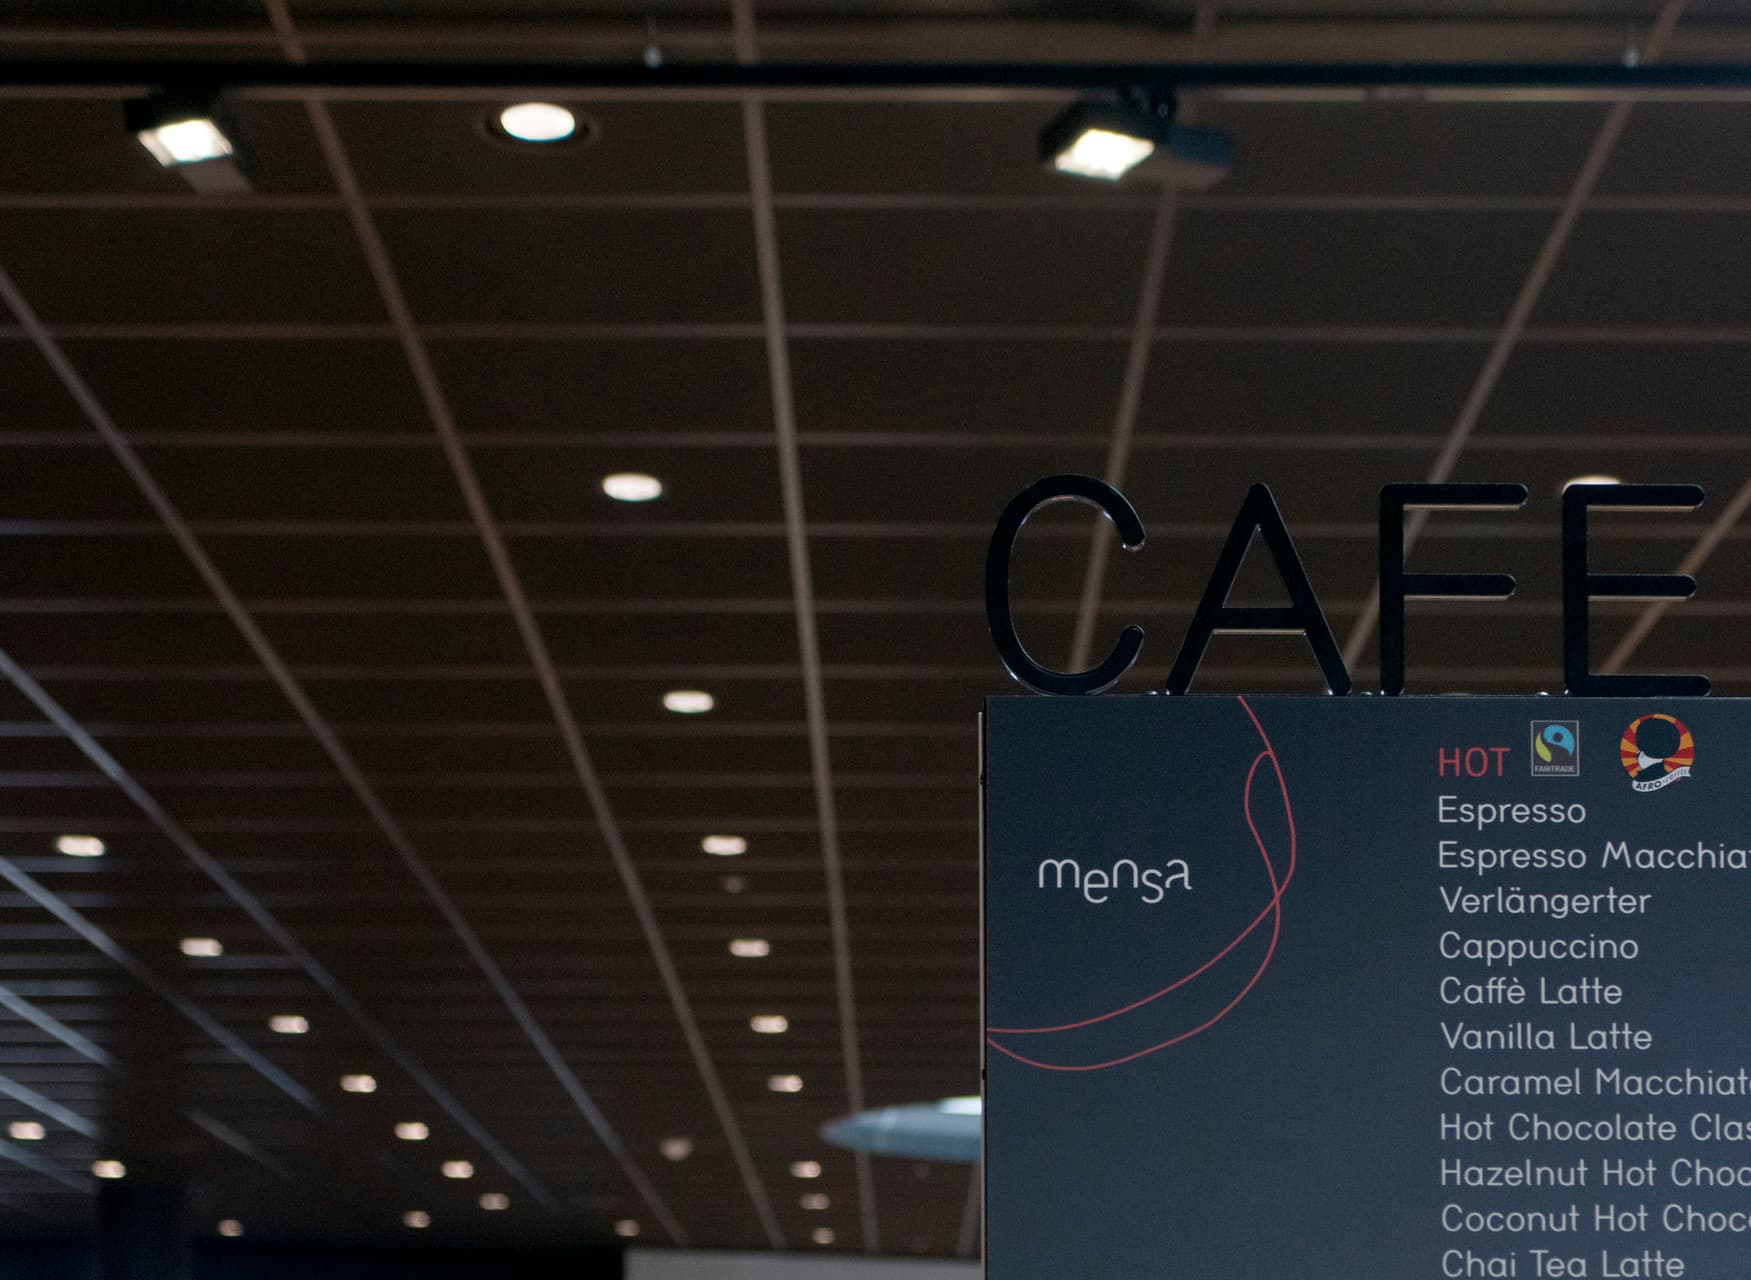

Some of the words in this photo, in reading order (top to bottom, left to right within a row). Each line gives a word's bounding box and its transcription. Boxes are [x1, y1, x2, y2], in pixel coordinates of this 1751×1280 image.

[984, 473, 1713, 696] CAFE
[1439, 746, 1510, 778] HOT
[1534, 765, 1576, 774] FAIRTRADE
[1438, 795, 1587, 831] Espresso
[1438, 840, 1587, 877] Espresso
[1601, 841, 1751, 870] Macchia
[1038, 858, 1193, 904] mensa
[1439, 886, 1652, 920] Verlängerter
[1439, 930, 1639, 967] Cappuccino
[1440, 976, 1526, 1005] Caffè
[1540, 976, 1623, 1005] Latte
[1440, 1021, 1555, 1050] Vanilla
[1570, 1022, 1653, 1050] Latte
[1440, 1066, 1581, 1096] Caramel
[1596, 1067, 1751, 1096] Macchiat
[1440, 1112, 1495, 1141] Hot
[1508, 1112, 1677, 1141] Chocolate
[1441, 1158, 1589, 1187] Hazelnut
[1603, 1158, 1657, 1187] Hot
[1441, 1203, 1580, 1233] Coconut
[1594, 1204, 1649, 1233] Hot
[1662, 1203, 1751, 1233] Choc
[1442, 1249, 1516, 1278] Chai
[1529, 1249, 1587, 1278] Tea
[1602, 1249, 1685, 1278] Latte
